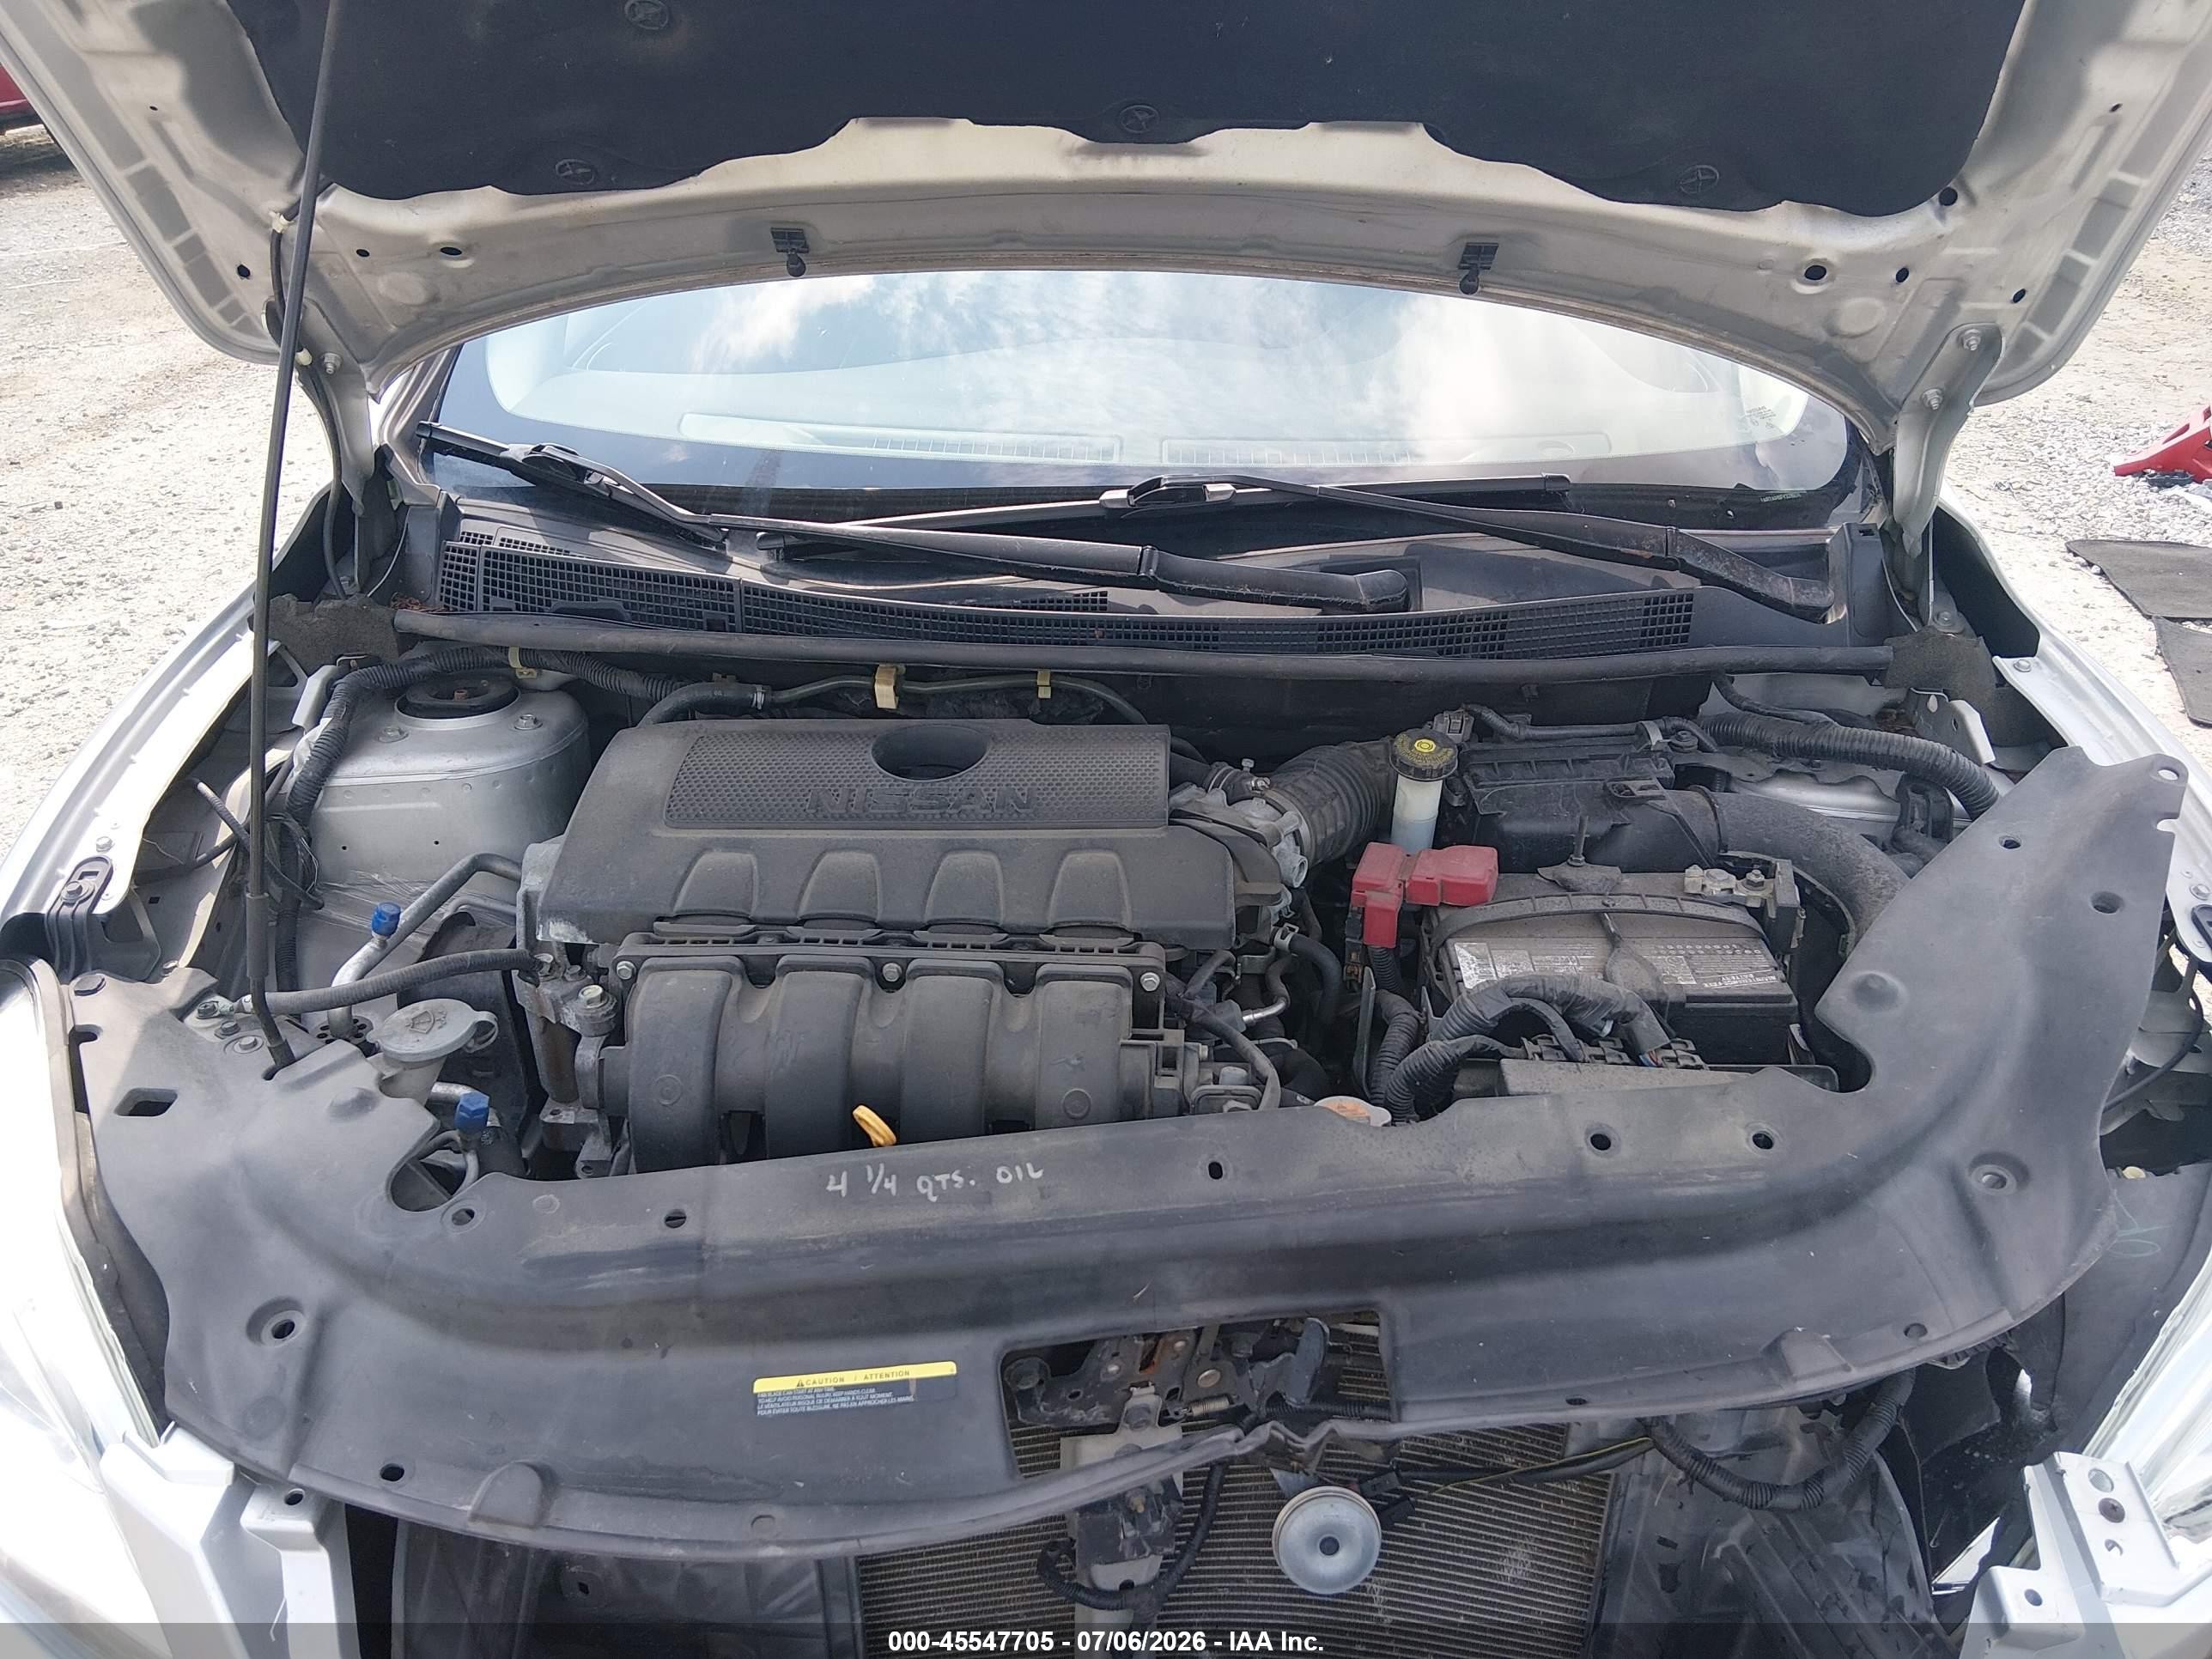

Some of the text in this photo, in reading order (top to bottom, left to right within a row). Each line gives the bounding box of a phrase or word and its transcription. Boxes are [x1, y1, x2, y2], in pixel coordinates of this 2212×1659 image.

[806, 787, 1036, 813] NISSAN
[826, 1170, 848, 1198] 4
[996, 1162, 1044, 1184] OIL
[805, 1376, 845, 1386] CAUTION
[863, 1370, 910, 1380] ATTENTION
